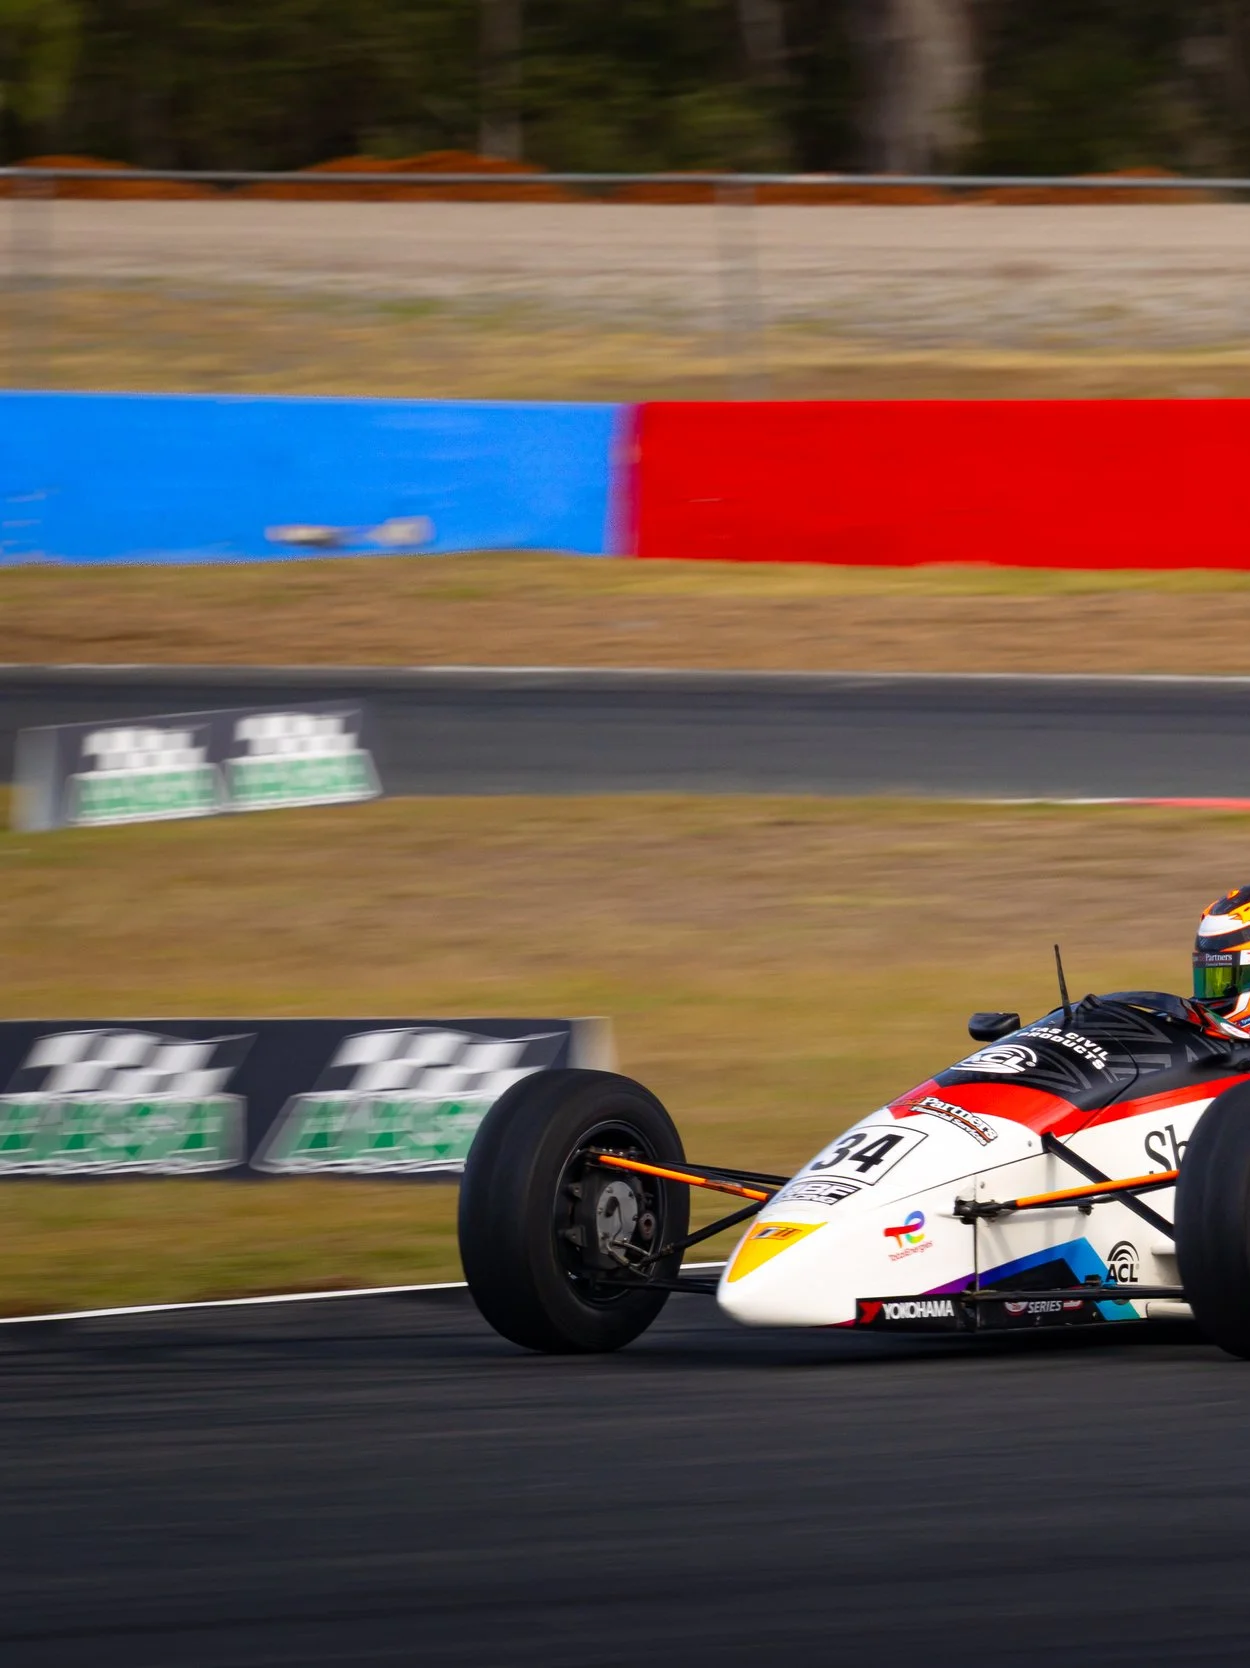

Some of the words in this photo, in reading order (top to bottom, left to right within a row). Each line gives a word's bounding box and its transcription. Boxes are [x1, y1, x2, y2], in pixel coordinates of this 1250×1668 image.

[1016, 1030, 1106, 1070] PRODUCTS
[1029, 1026, 1062, 1035] TAS
[1064, 1031, 1110, 1061] CIVIL
[918, 1096, 998, 1141] Partners
[810, 1132, 904, 1173] 34
[1105, 1263, 1139, 1283] ACL
[882, 1300, 955, 1320] YOKOHAMA
[1027, 1299, 1063, 1314] SERIES
